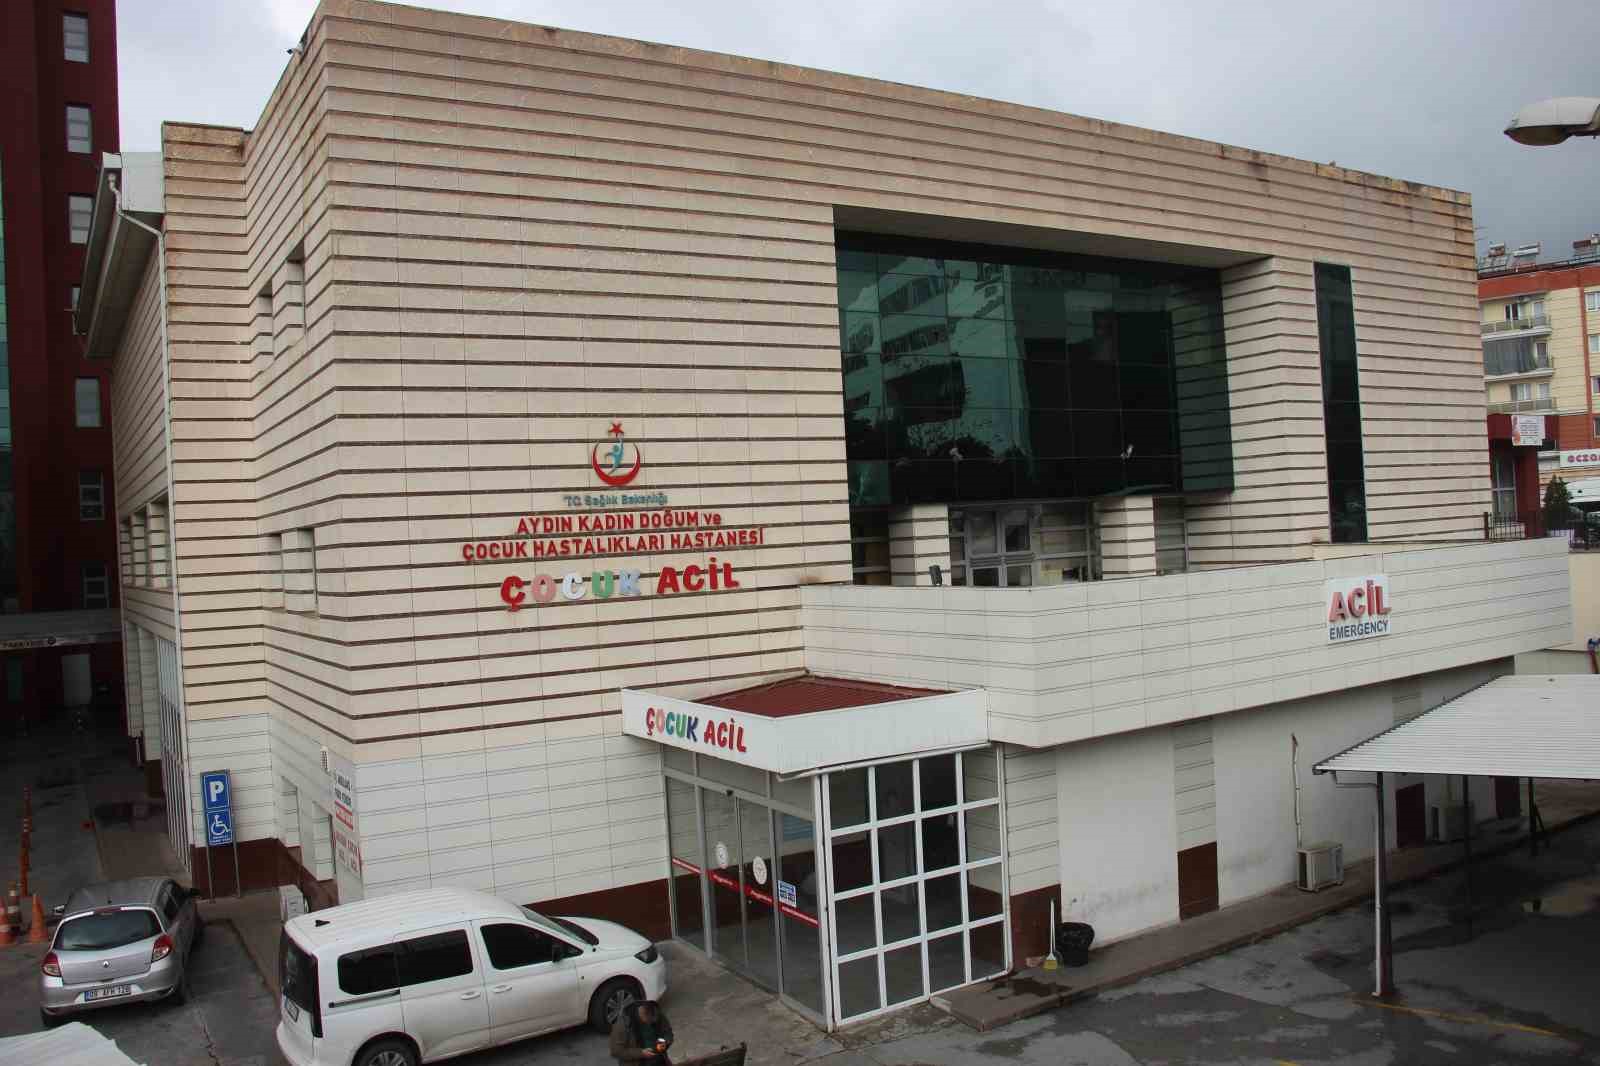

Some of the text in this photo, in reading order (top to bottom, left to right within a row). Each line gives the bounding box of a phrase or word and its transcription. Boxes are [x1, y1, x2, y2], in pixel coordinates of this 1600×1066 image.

[517, 508, 722, 534] AYDIN KADIN DOĞUM ve
[533, 534, 665, 556] HASTALIKLARI
[670, 527, 764, 550] HASTANESİ
[500, 557, 739, 612] ÇOCUK ACİL
[1328, 579, 1392, 622] ACİL
[1330, 620, 1389, 640] EMERGENCY
[646, 707, 747, 753] ÇOCUK ACİL
[209, 781, 225, 801] P
